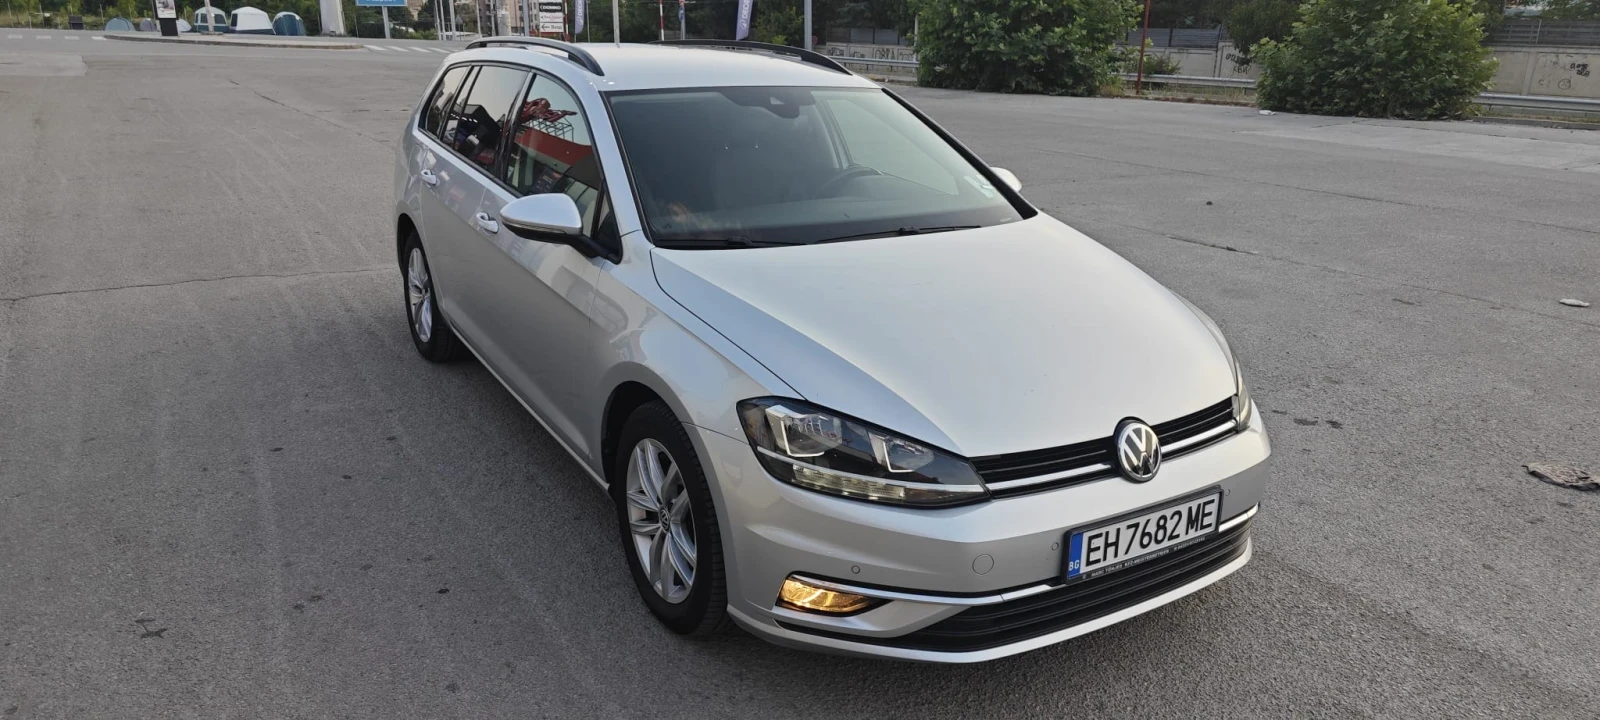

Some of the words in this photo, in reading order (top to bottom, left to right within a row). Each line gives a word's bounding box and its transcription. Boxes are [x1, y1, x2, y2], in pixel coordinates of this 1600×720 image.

[1086, 527, 1121, 567] EH
[1124, 510, 1183, 555] 7682
[1185, 499, 1215, 535] ME
[1069, 560, 1080, 572] BG
